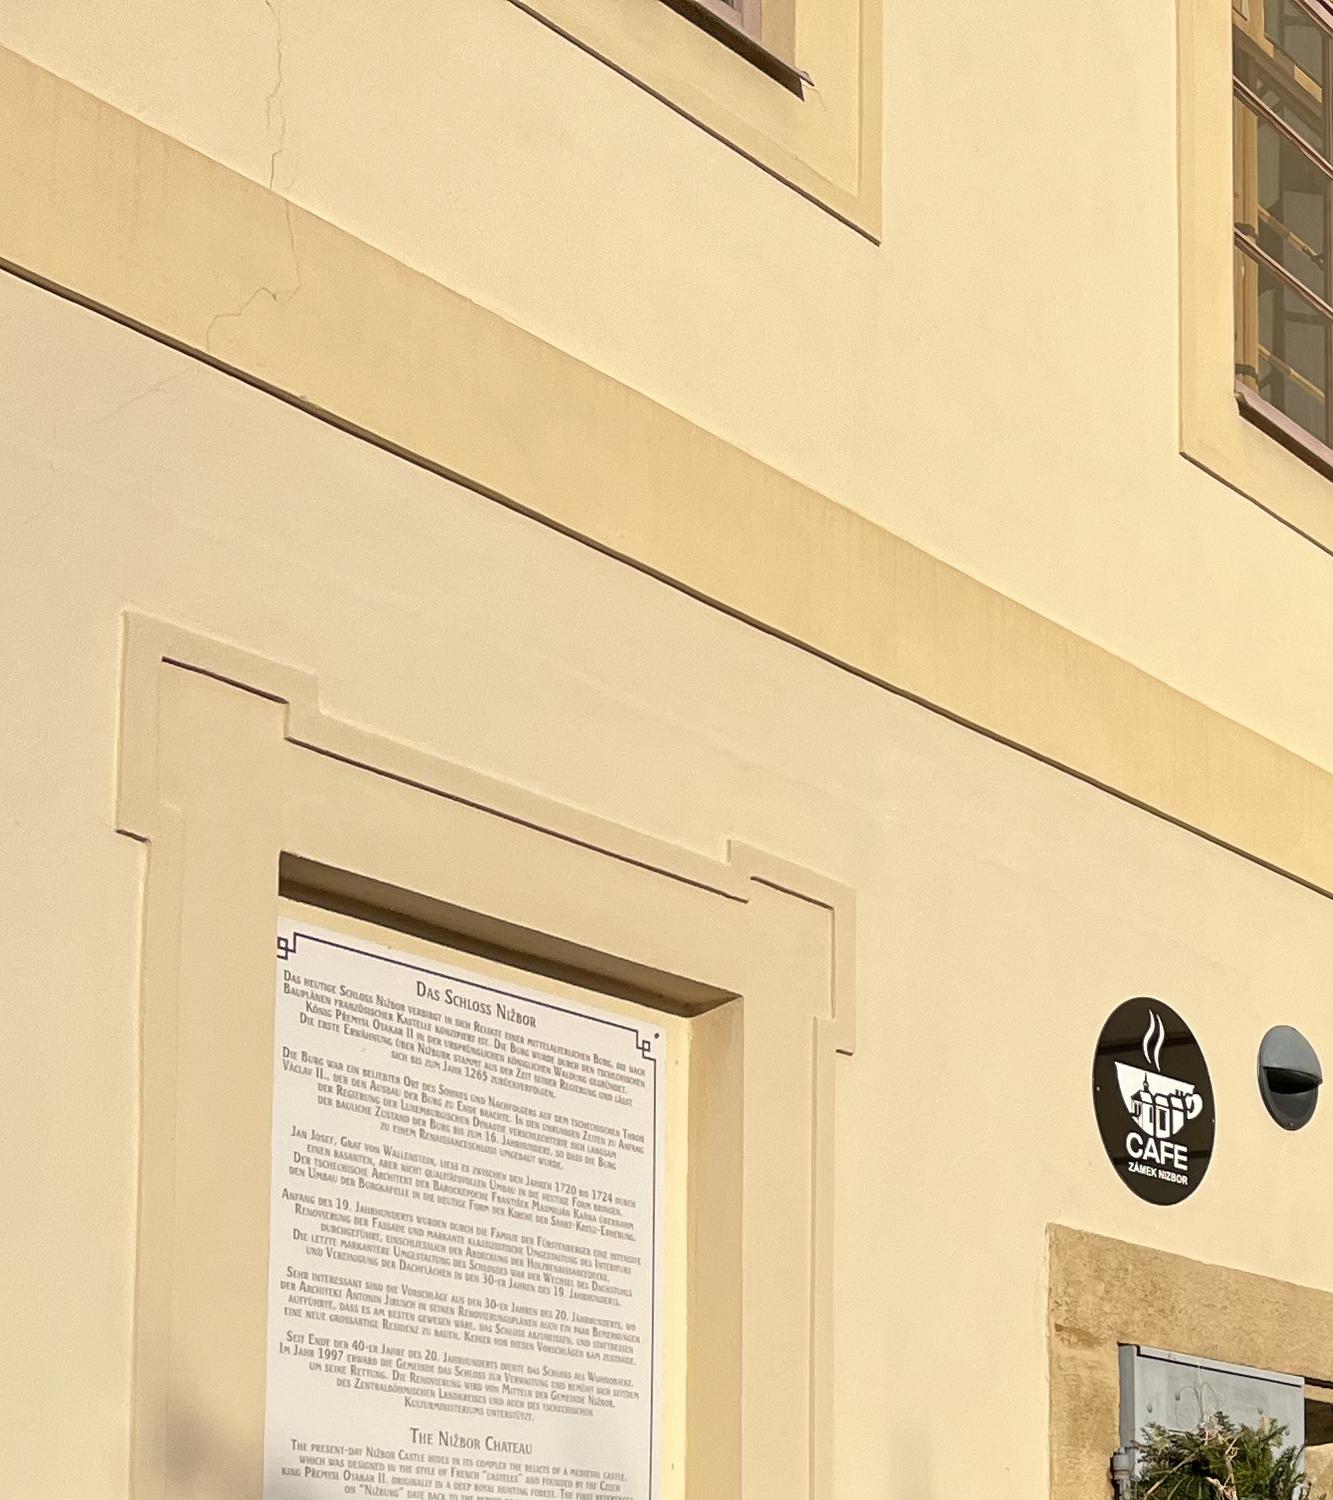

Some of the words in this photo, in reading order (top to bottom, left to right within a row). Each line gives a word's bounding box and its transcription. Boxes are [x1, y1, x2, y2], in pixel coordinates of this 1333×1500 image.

[1126, 1132, 1188, 1171] CAFE
[1128, 1161, 1157, 1178] ZÁMEK
[555, 1181, 576, 1195] 1720
[592, 1189, 612, 1203] 1724
[318, 1347, 343, 1361] 1997
[485, 1435, 532, 1455] CHATEAU
